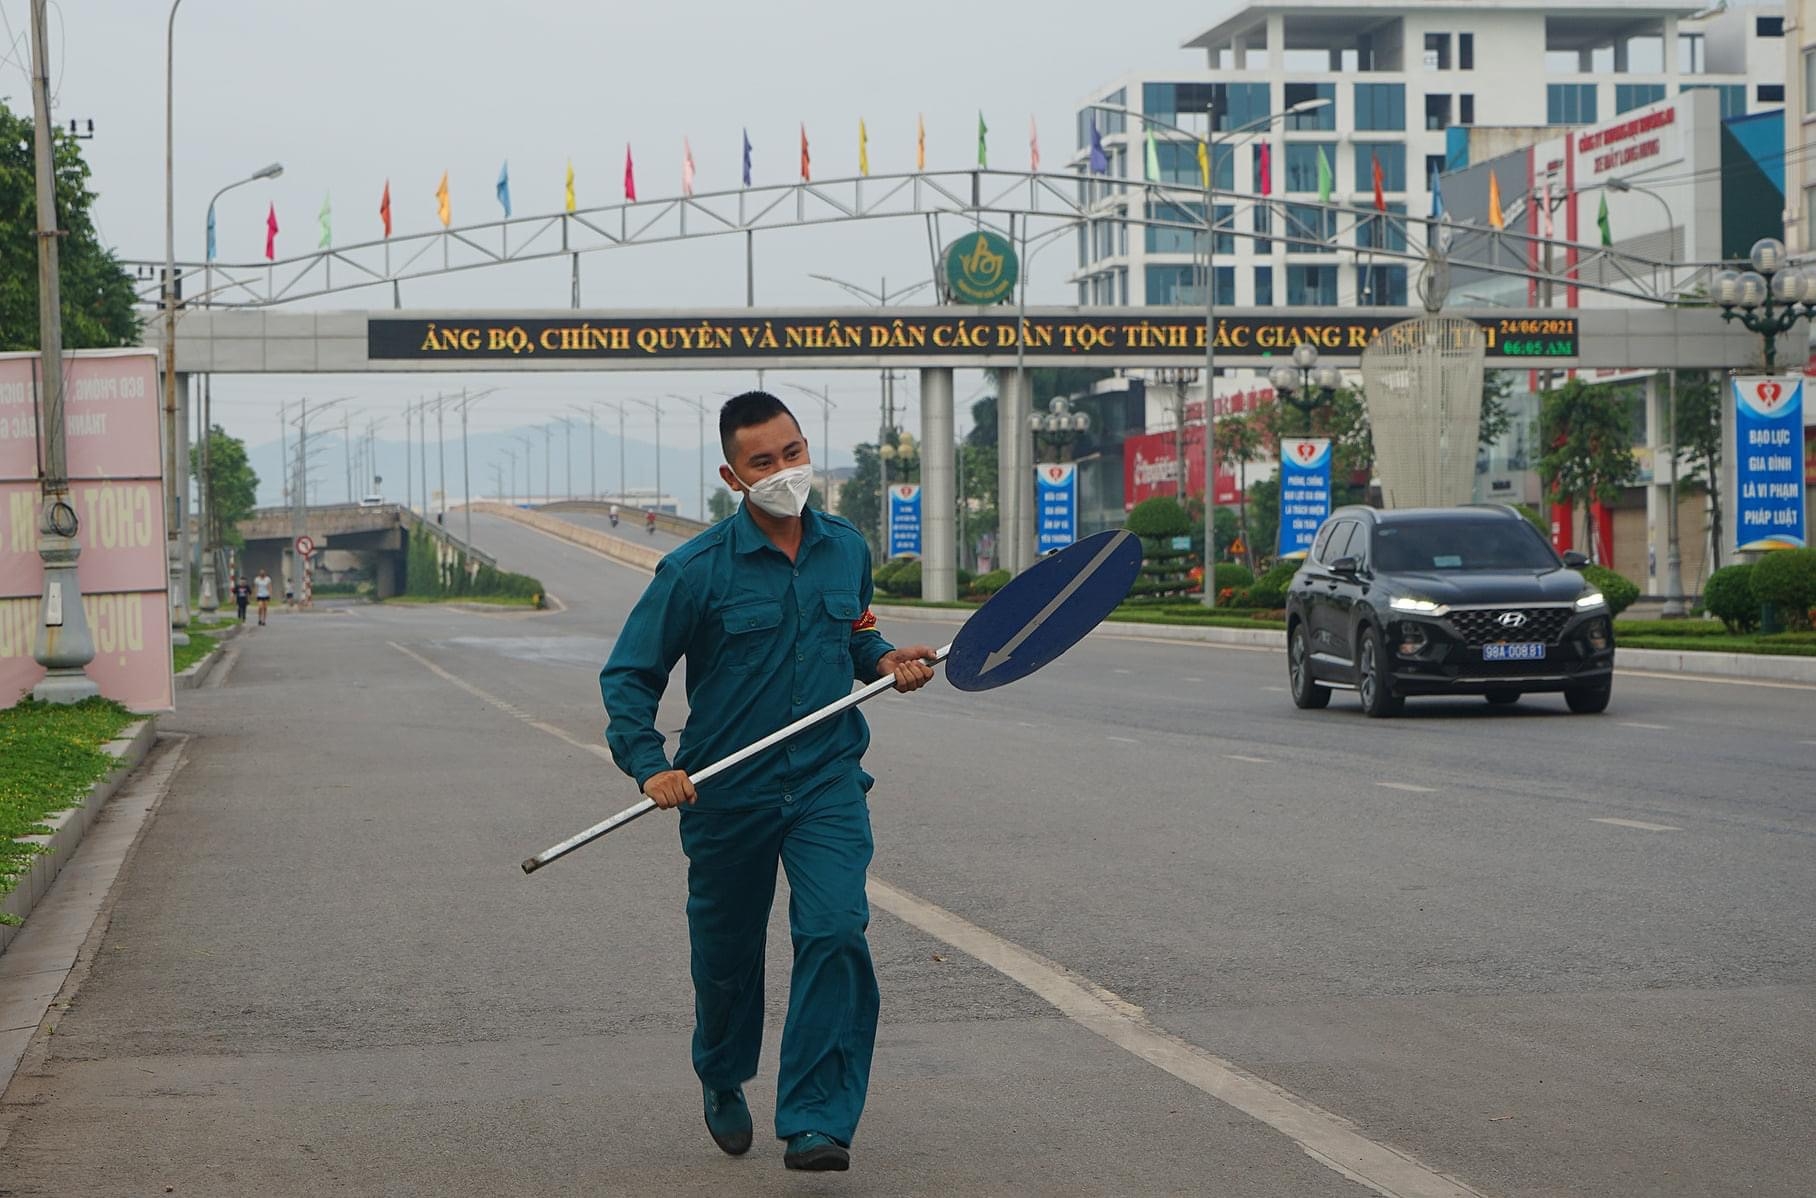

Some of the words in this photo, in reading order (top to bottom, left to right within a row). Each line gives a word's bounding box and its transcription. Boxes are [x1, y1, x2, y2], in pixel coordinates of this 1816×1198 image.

[421, 323, 482, 351] ẢNG
[487, 325, 534, 354] BỘ,
[540, 322, 630, 351] CHÍNH
[636, 320, 732, 353] QUYỀN
[739, 321, 779, 349] VÀ
[785, 319, 862, 348] NHÂN
[869, 319, 927, 348] DÂN
[932, 320, 991, 348] CÁC
[996, 319, 1052, 347] DÂN
[1059, 323, 1116, 351] TỘC
[1122, 320, 1188, 347] TỈNH
[1255, 325, 1341, 348] GIANG
[1500, 320, 1574, 335] 24/06/2021
[1503, 340, 1542, 355] 06:05
[1546, 340, 1573, 355] AM
[1749, 429, 1770, 448] BẠO
[1771, 427, 1790, 448] LỰC
[1748, 456, 1766, 472] GIA
[1768, 453, 1792, 472] ĐÌNH
[1743, 480, 1756, 498] LÀ
[1757, 483, 1768, 498] VI
[1769, 483, 1799, 501] PHẠM
[1744, 507, 1772, 525] PHÁP
[1773, 507, 1798, 528] LUẬT
